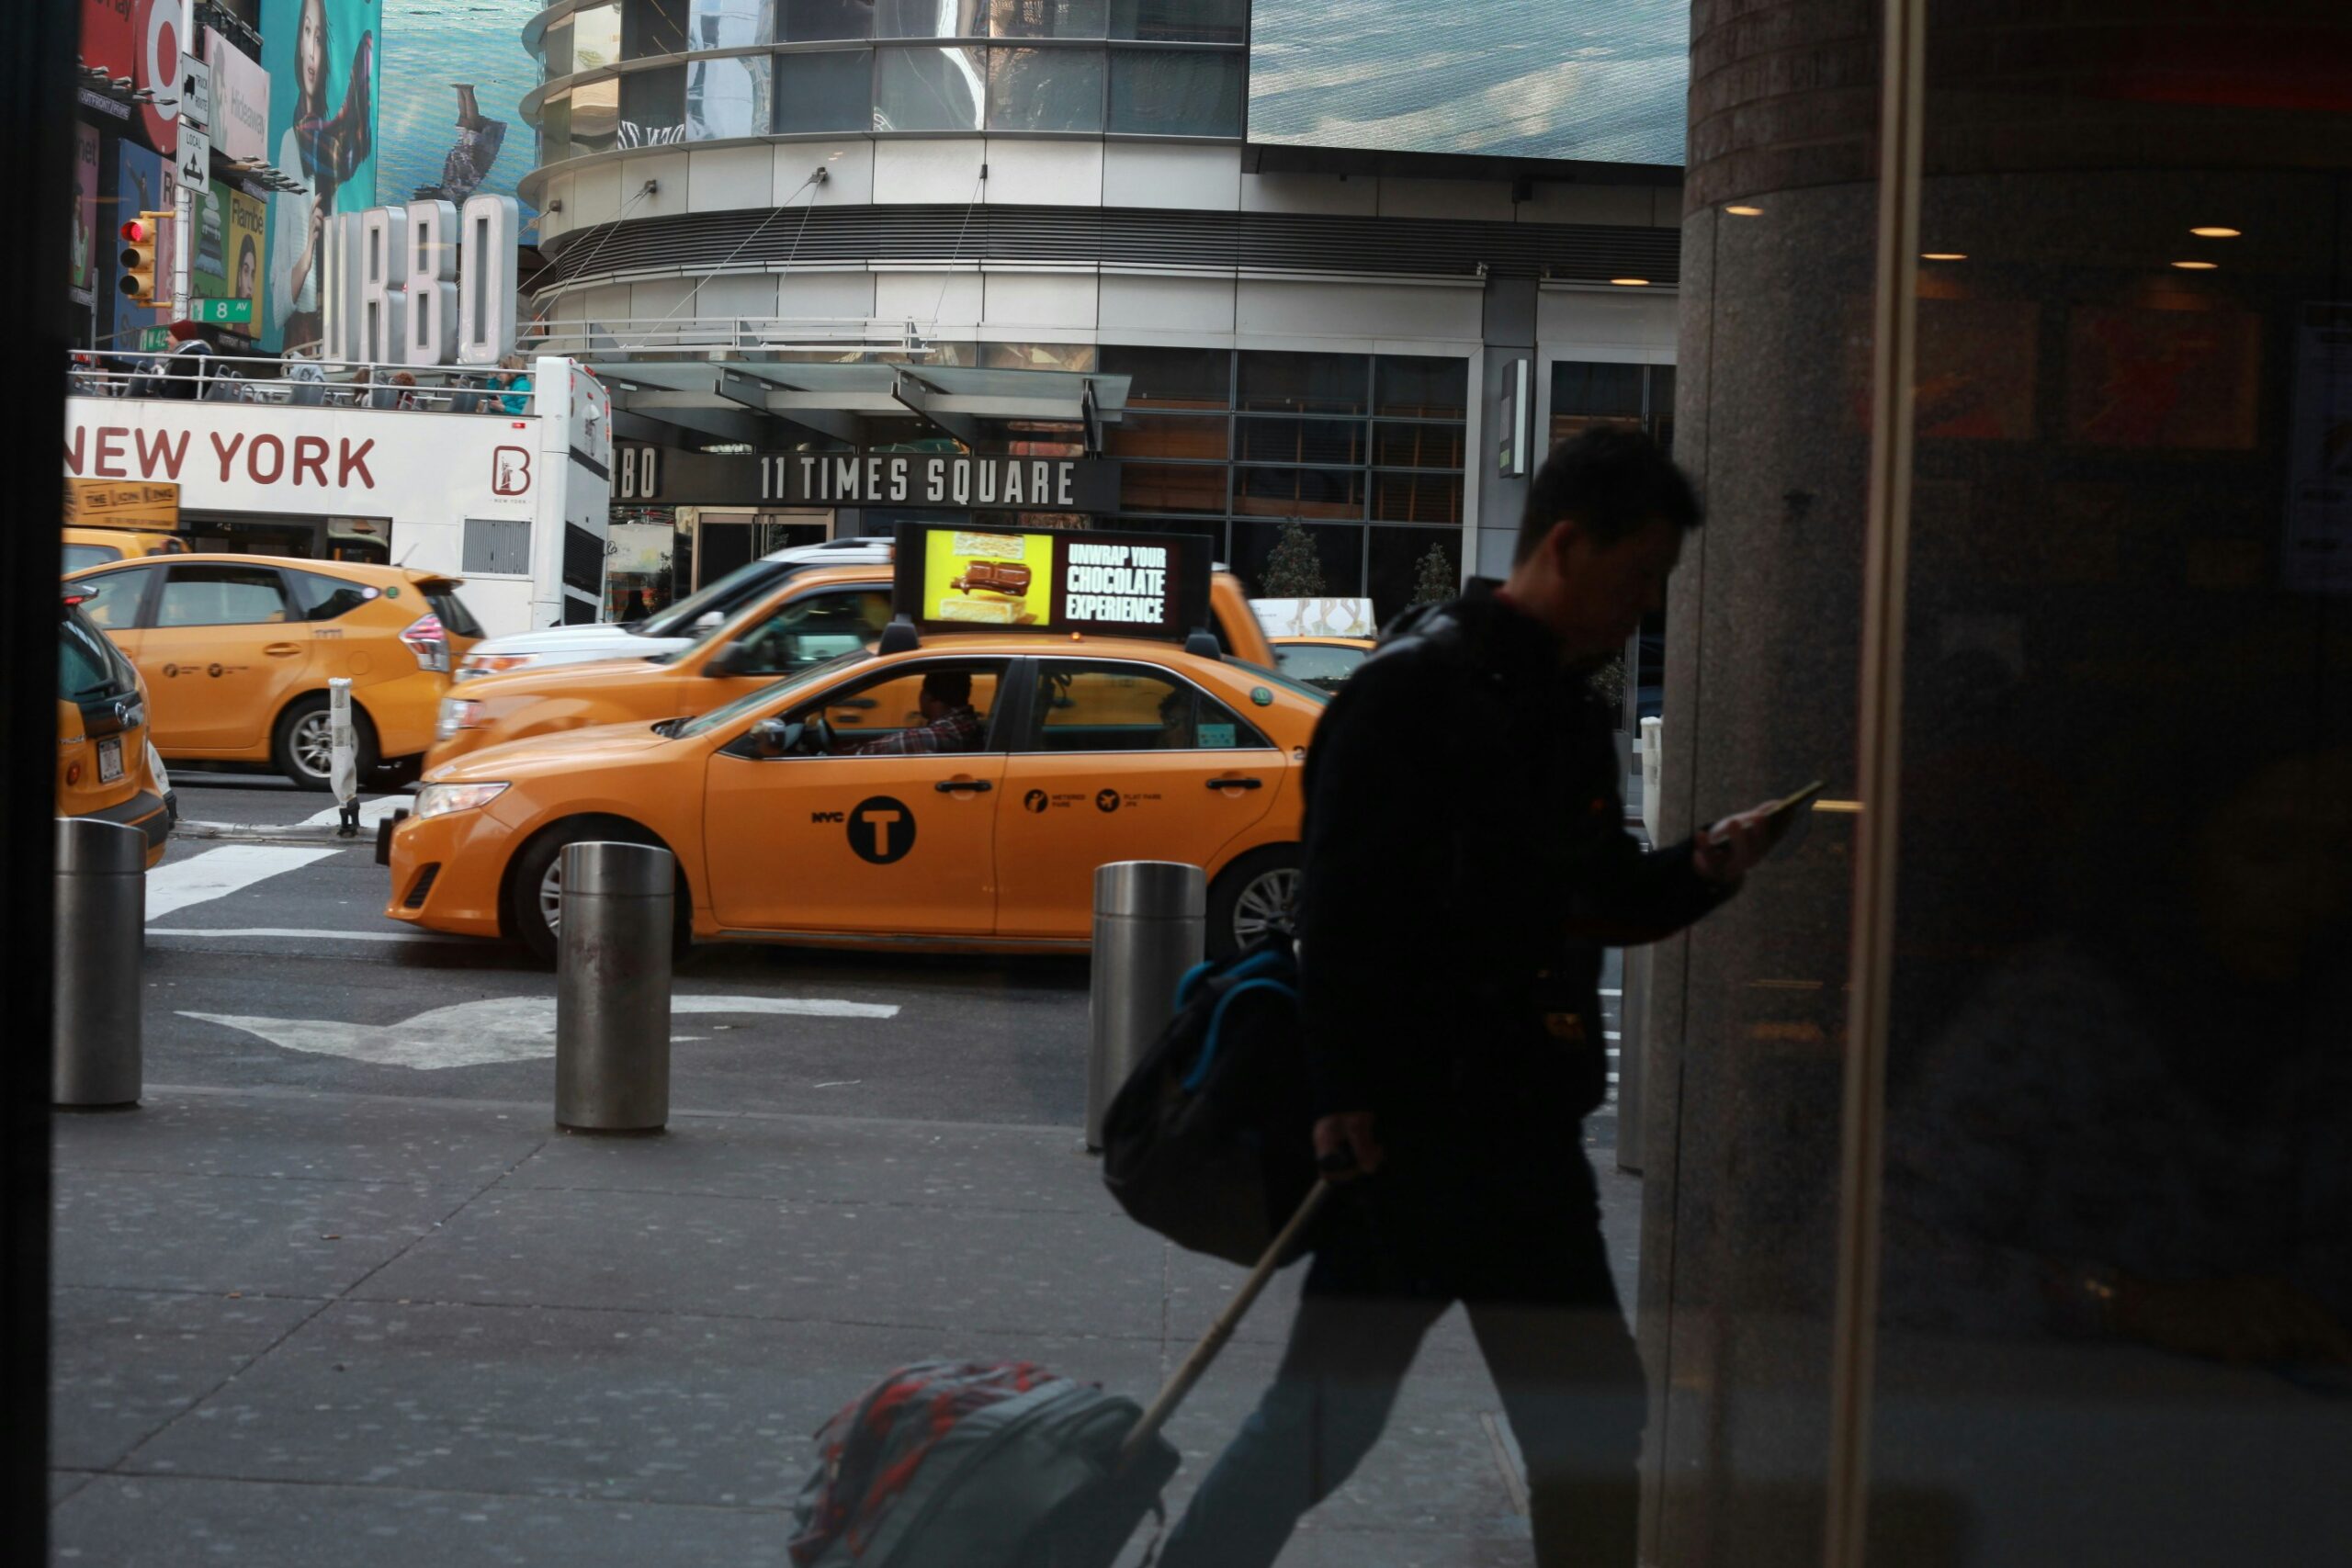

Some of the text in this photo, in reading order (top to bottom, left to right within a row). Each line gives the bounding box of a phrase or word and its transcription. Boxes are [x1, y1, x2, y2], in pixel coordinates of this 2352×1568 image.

[196, 73, 209, 89] TRUCK
[195, 95, 209, 112] ROUTE
[232, 87, 266, 142] Hideaway
[187, 133, 202, 150] LOCAL
[232, 198, 265, 234] Flambé
[216, 302, 247, 319] 8 AV
[210, 431, 375, 490] YORK
[762, 457, 1074, 505] 11 TIMES SQUARE
[1069, 543, 1167, 569] UNWRAP YOUR
[1067, 565, 1166, 596] CHOCOLATE
[1066, 593, 1165, 624] EXPERIENCE
[811, 810, 900, 856] NYC T
